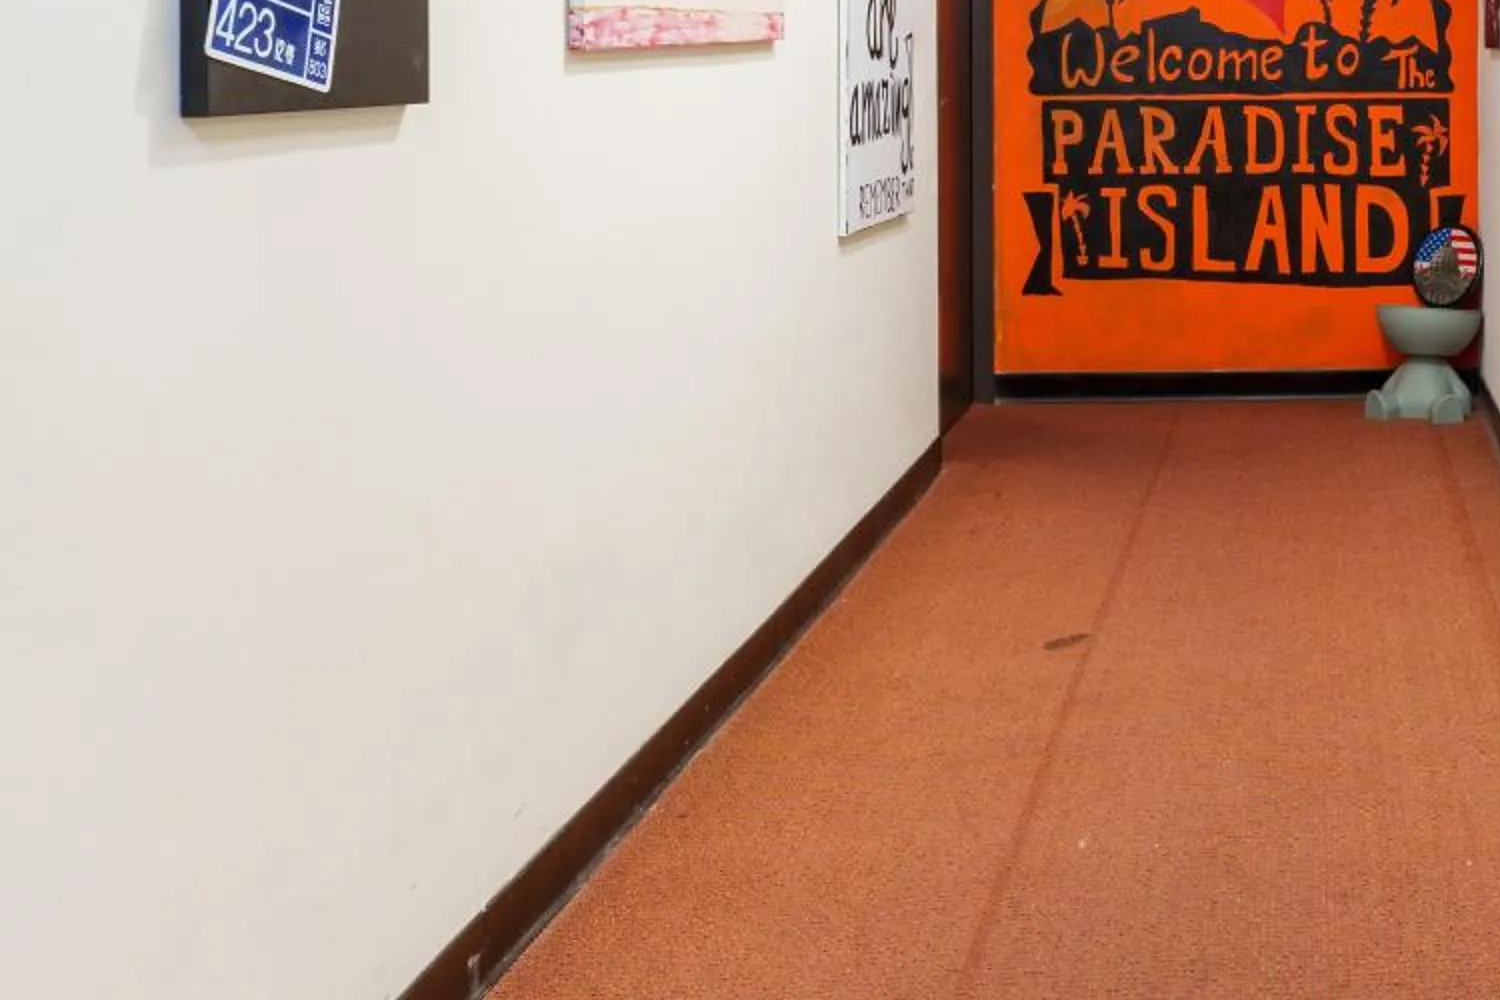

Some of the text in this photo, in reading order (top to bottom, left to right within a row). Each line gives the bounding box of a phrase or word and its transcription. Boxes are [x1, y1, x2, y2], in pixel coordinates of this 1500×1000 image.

[1061, 32, 1436, 92] Welcome to The
[1050, 104, 1407, 178] PARADISE
[1096, 187, 1411, 275] ISLAND
